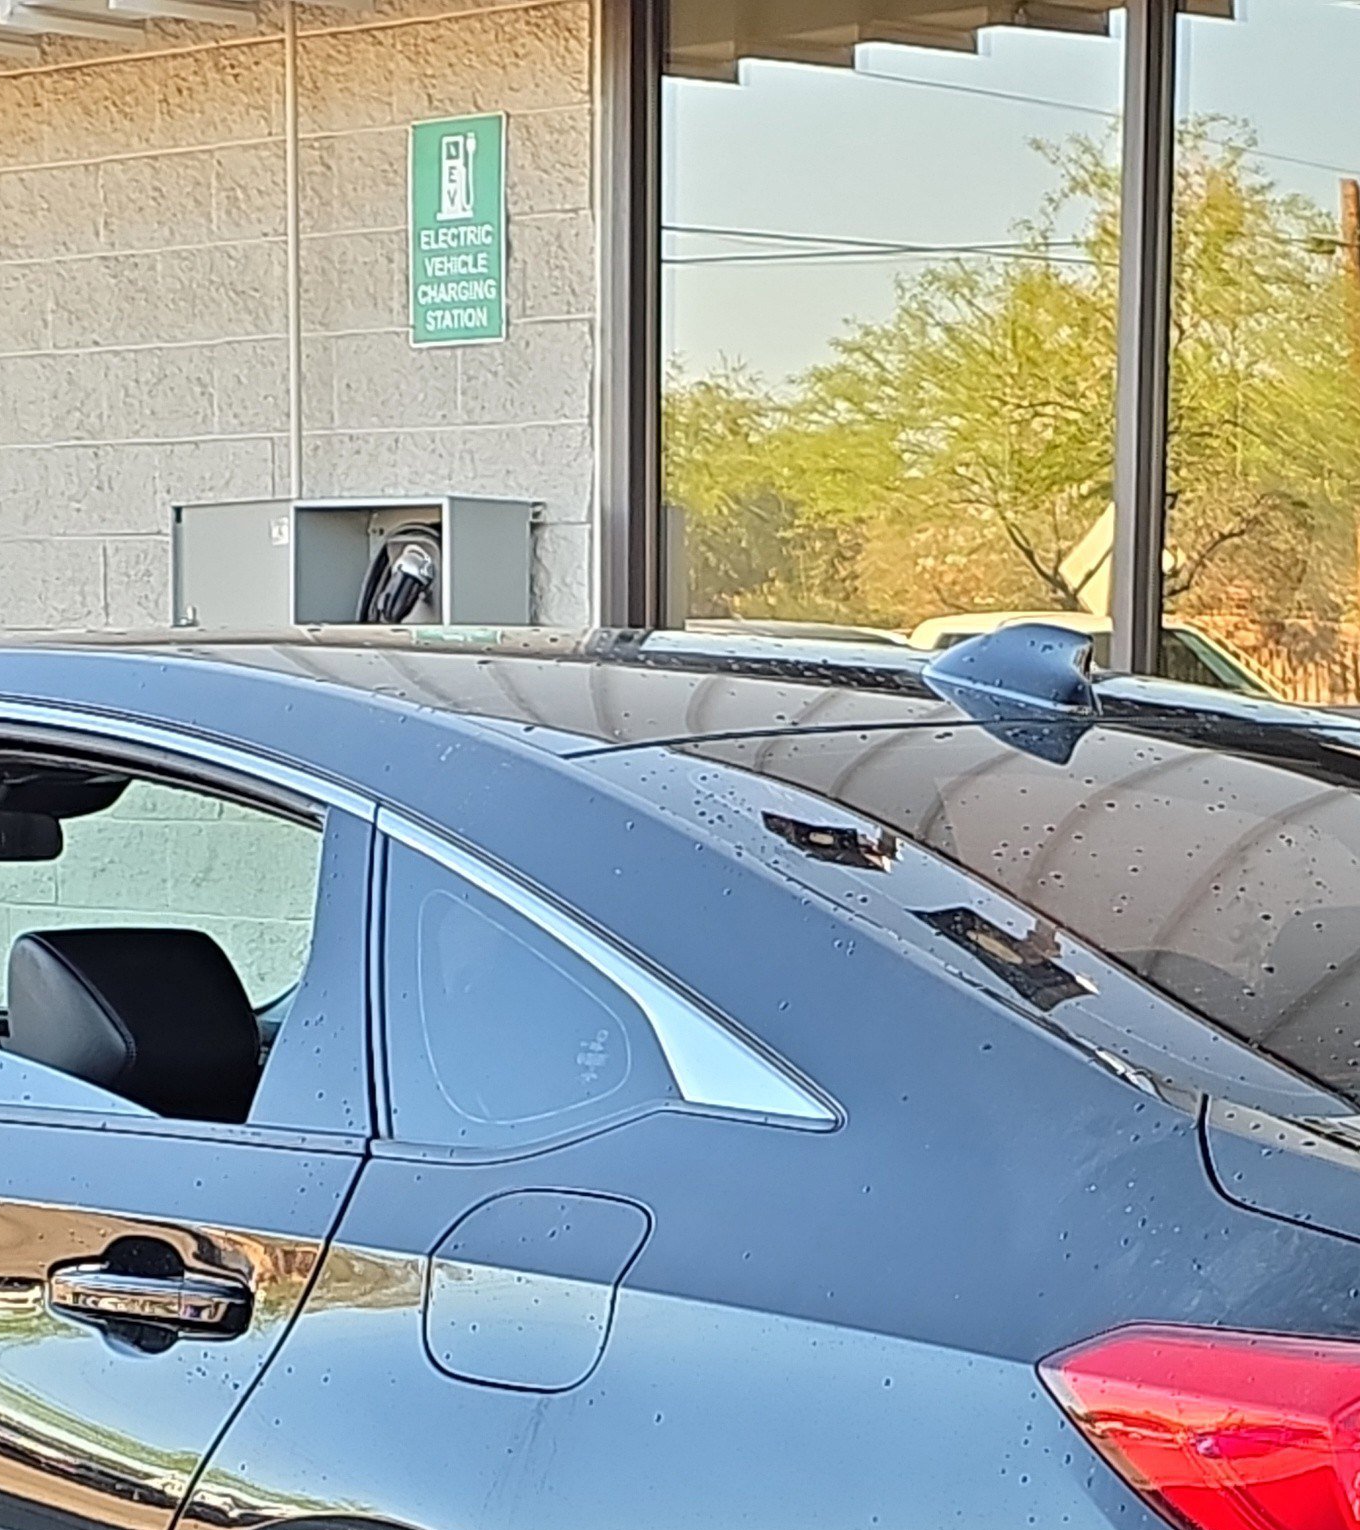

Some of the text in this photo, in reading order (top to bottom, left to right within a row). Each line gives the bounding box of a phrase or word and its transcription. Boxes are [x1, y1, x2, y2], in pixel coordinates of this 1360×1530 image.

[420, 224, 493, 250] ELECTRIC
[424, 253, 489, 277] VEHICLE
[417, 278, 497, 305] CHARGING
[425, 307, 488, 331] STATION
